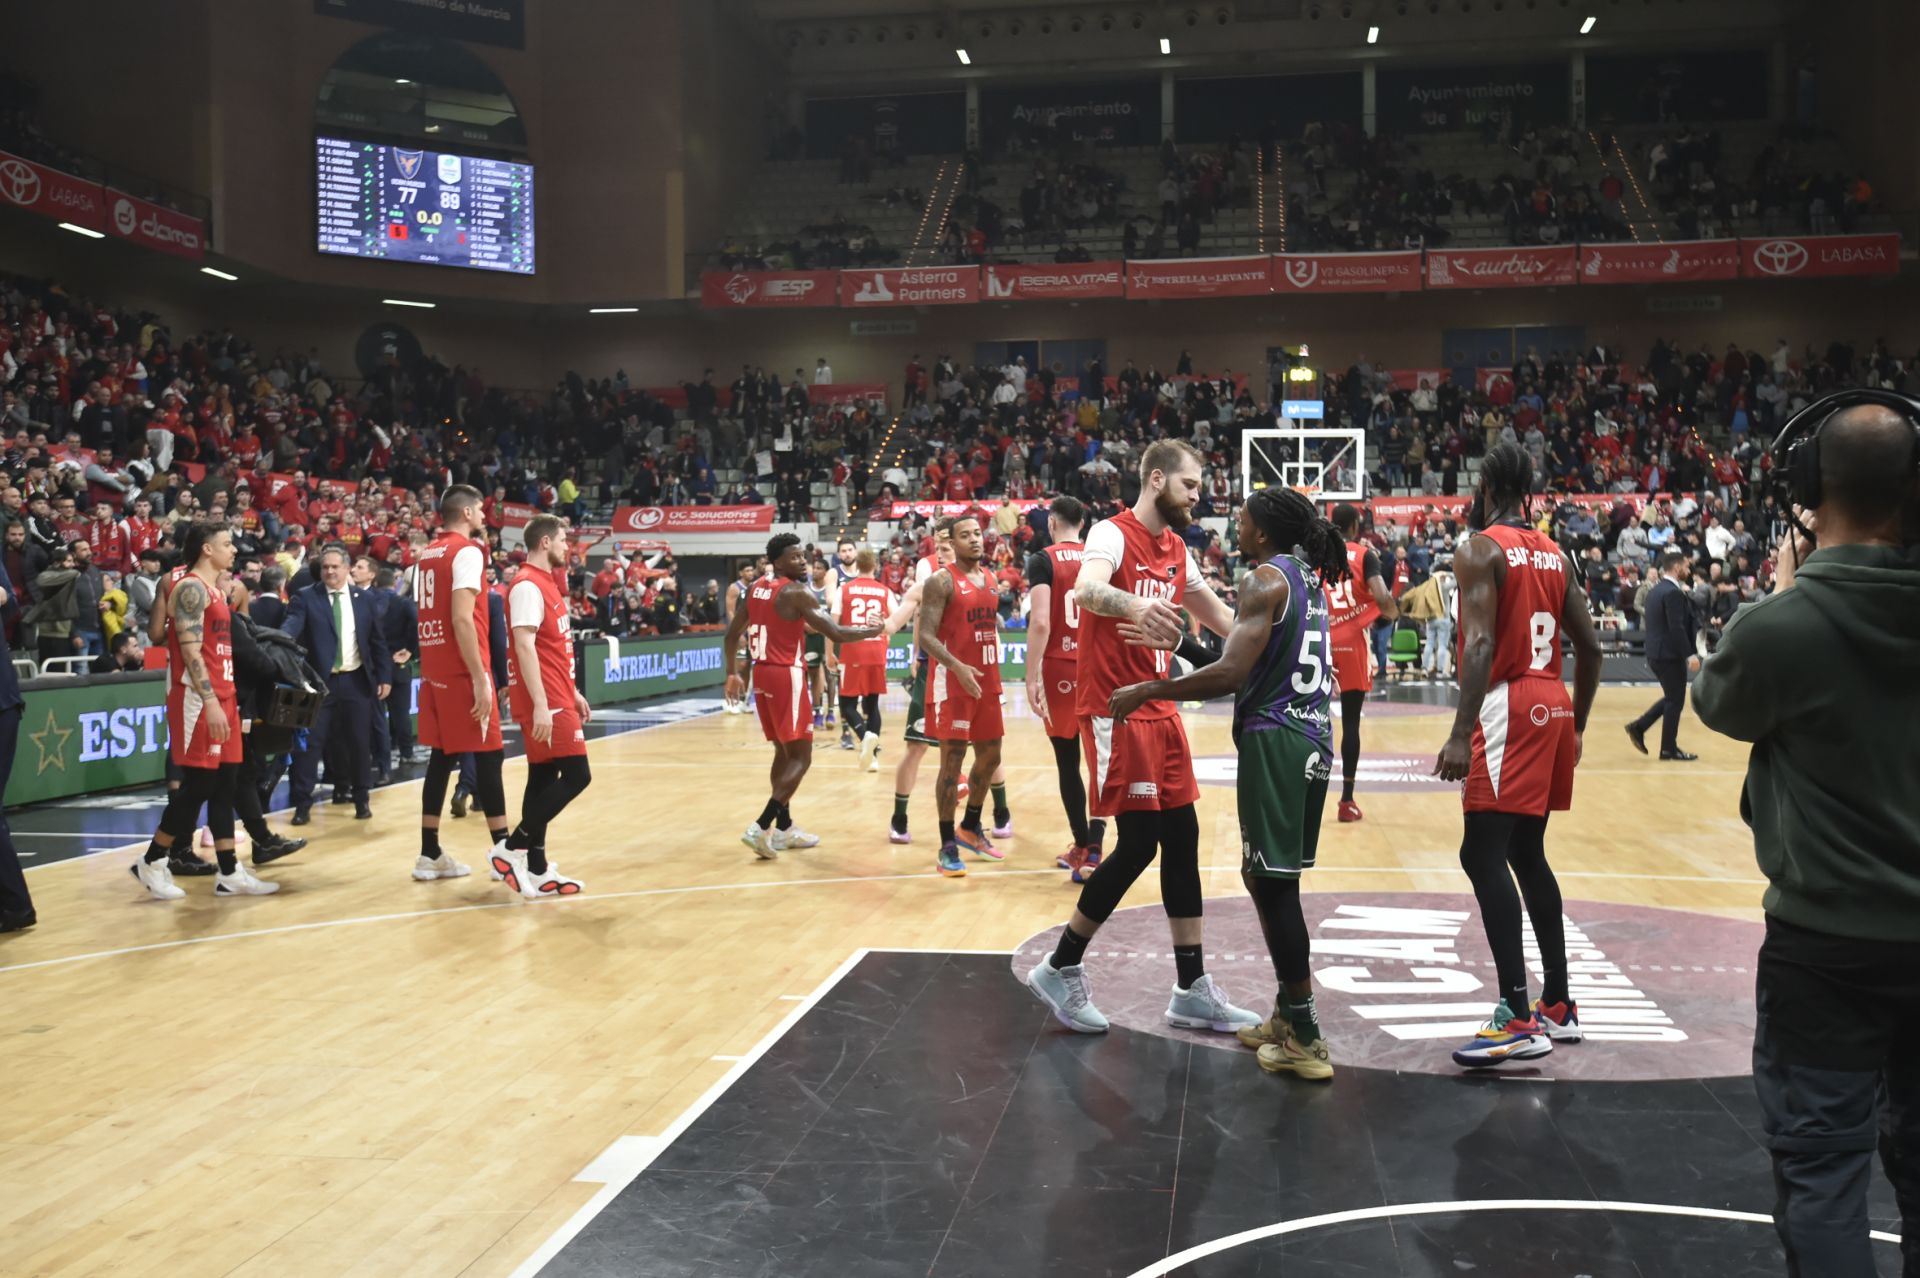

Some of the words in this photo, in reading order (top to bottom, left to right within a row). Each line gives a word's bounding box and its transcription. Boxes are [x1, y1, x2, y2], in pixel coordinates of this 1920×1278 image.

[398, 187, 418, 204] 77
[440, 192, 460, 209] 89
[417, 210, 442, 225] 0.0
[1820, 246, 1887, 263] LABASA
[900, 270, 958, 284] Asterra
[1019, 275, 1070, 287] IBERIA
[1072, 272, 1118, 285] VITAE
[1151, 273, 1207, 285] ESTRELLA
[1216, 271, 1266, 283] LEVANTE
[900, 286, 967, 301] Partners
[667, 518, 756, 526] Medioambientales
[690, 510, 757, 519] Soluciones
[419, 568, 435, 610] 19
[1529, 611, 1556, 670] 8
[675, 647, 721, 674] LEVANTE
[982, 644, 996, 665] 10
